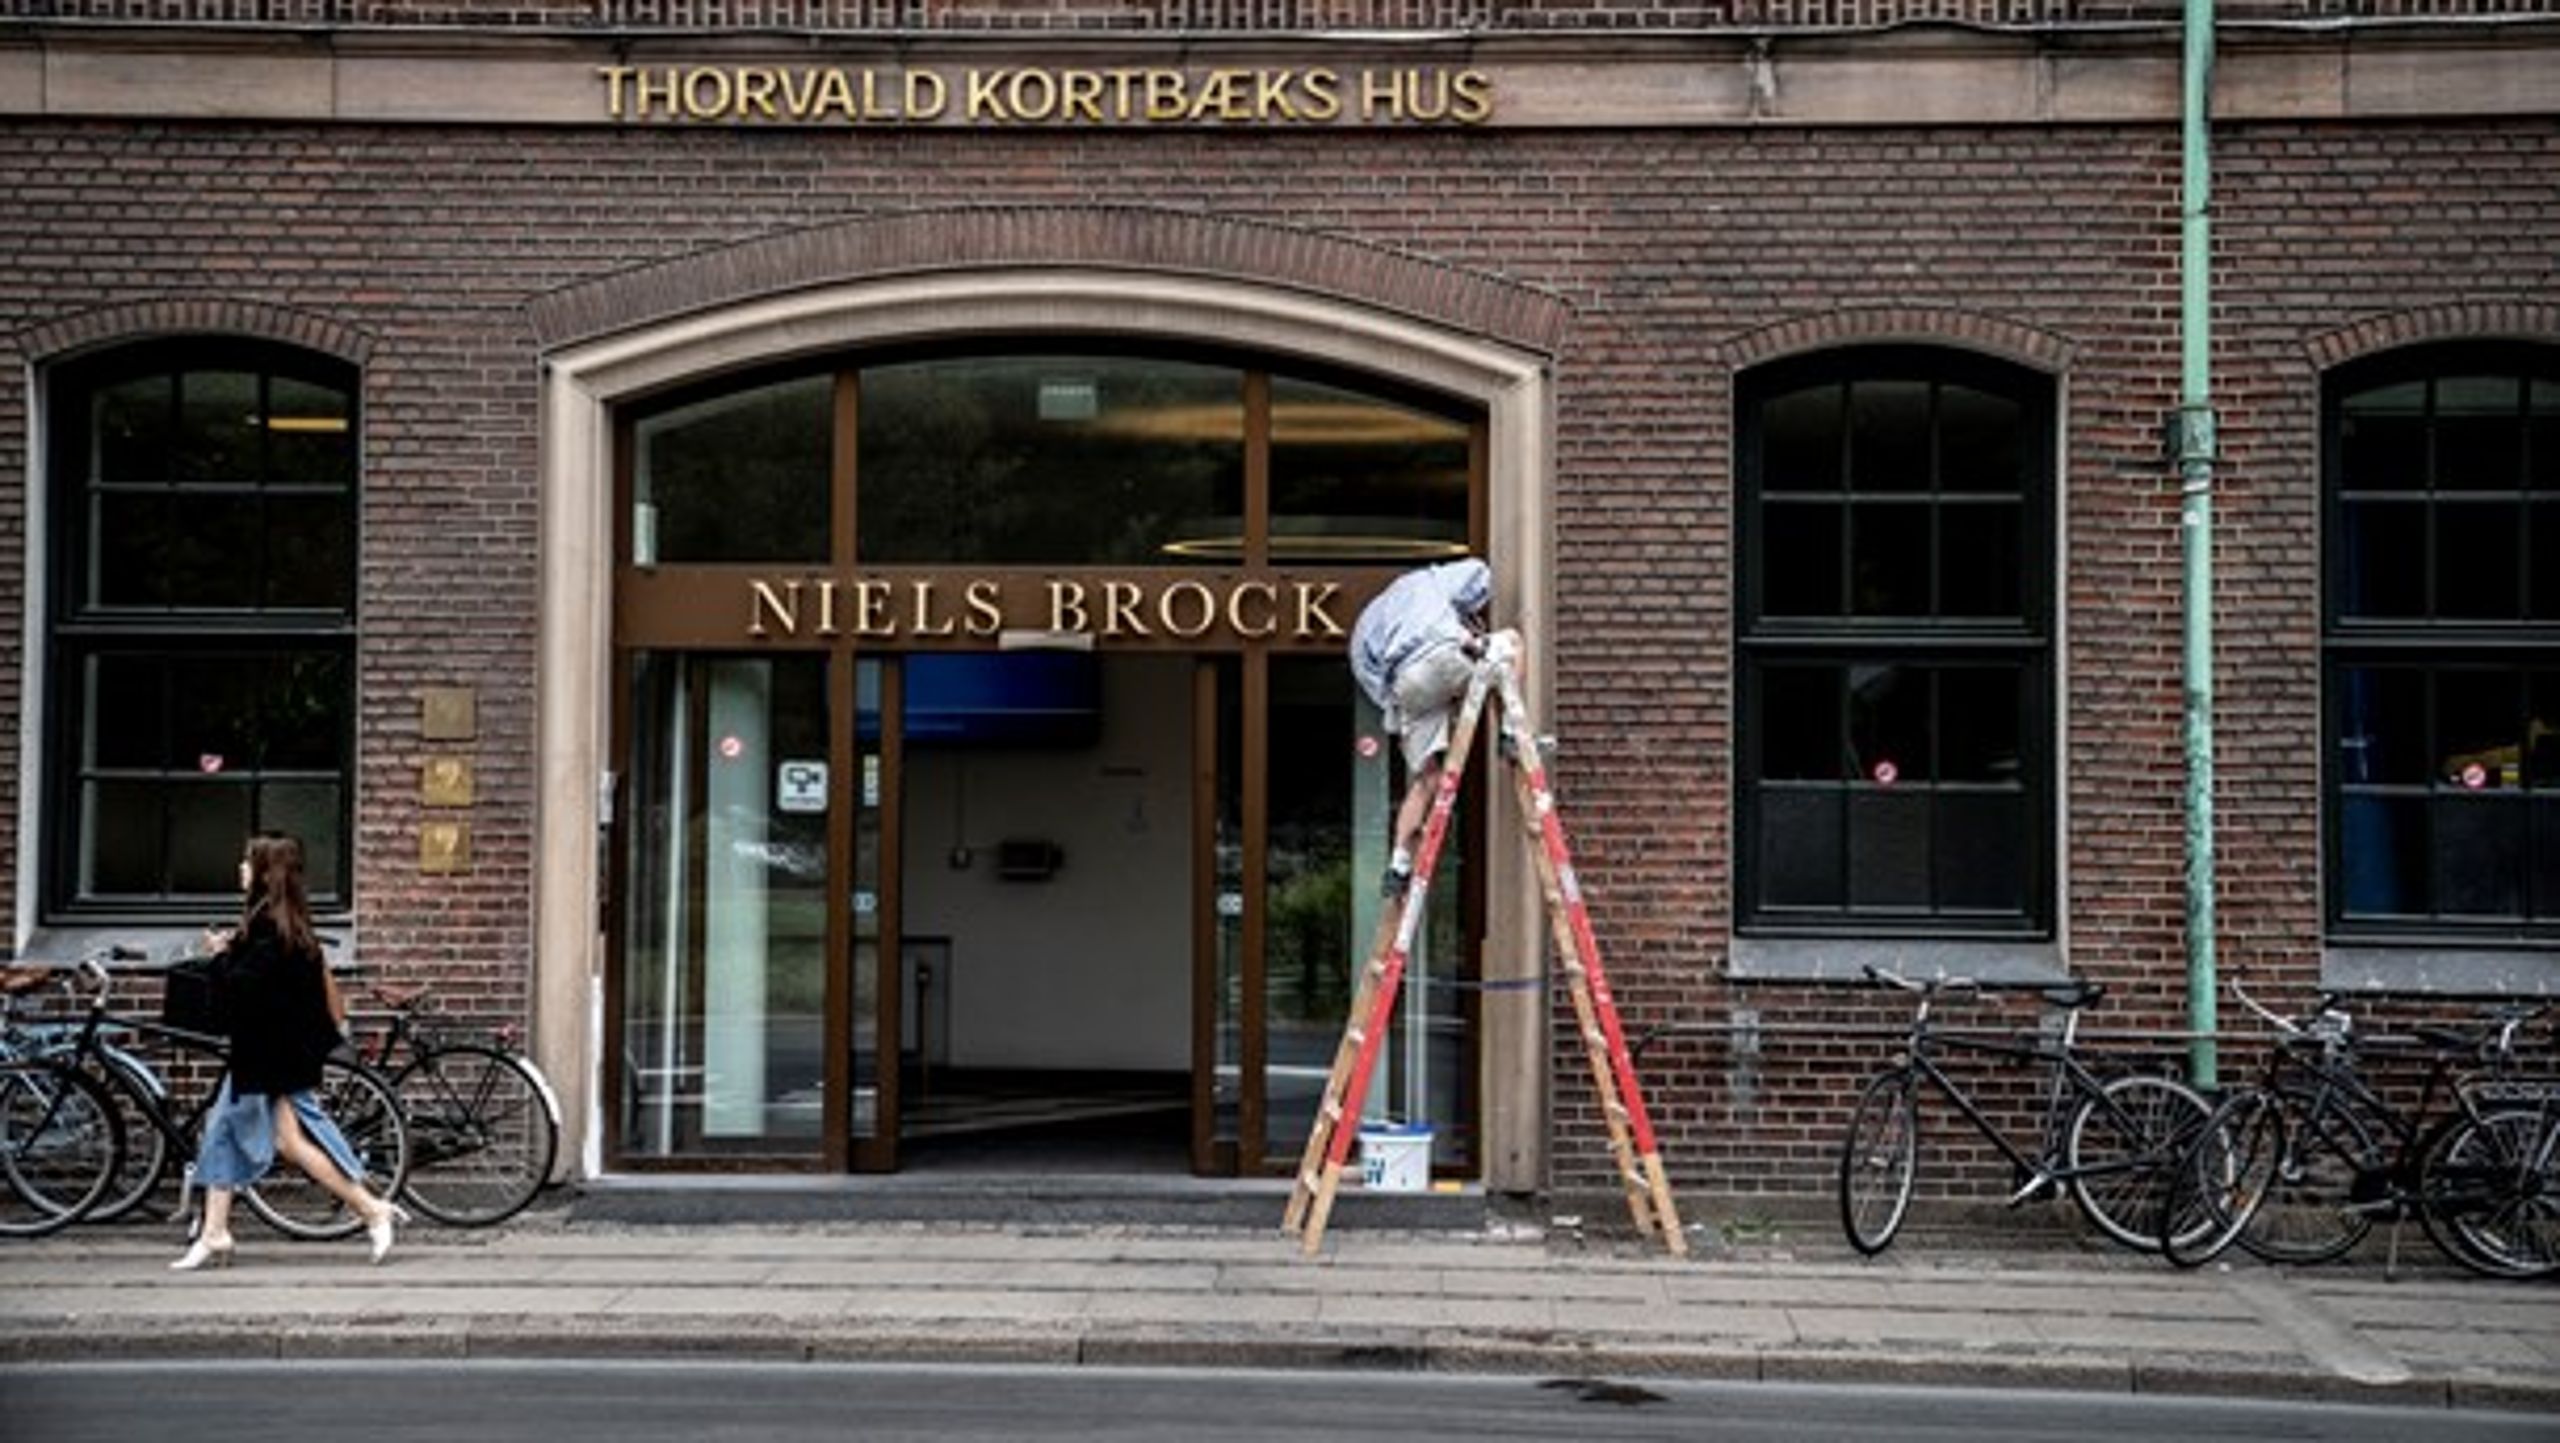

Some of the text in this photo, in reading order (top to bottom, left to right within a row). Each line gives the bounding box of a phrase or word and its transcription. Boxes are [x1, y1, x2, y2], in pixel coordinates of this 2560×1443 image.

[598, 66, 1494, 122] THORVALD KORTBÆKS HUS
[748, 579, 1345, 636] NIELS BROCK
